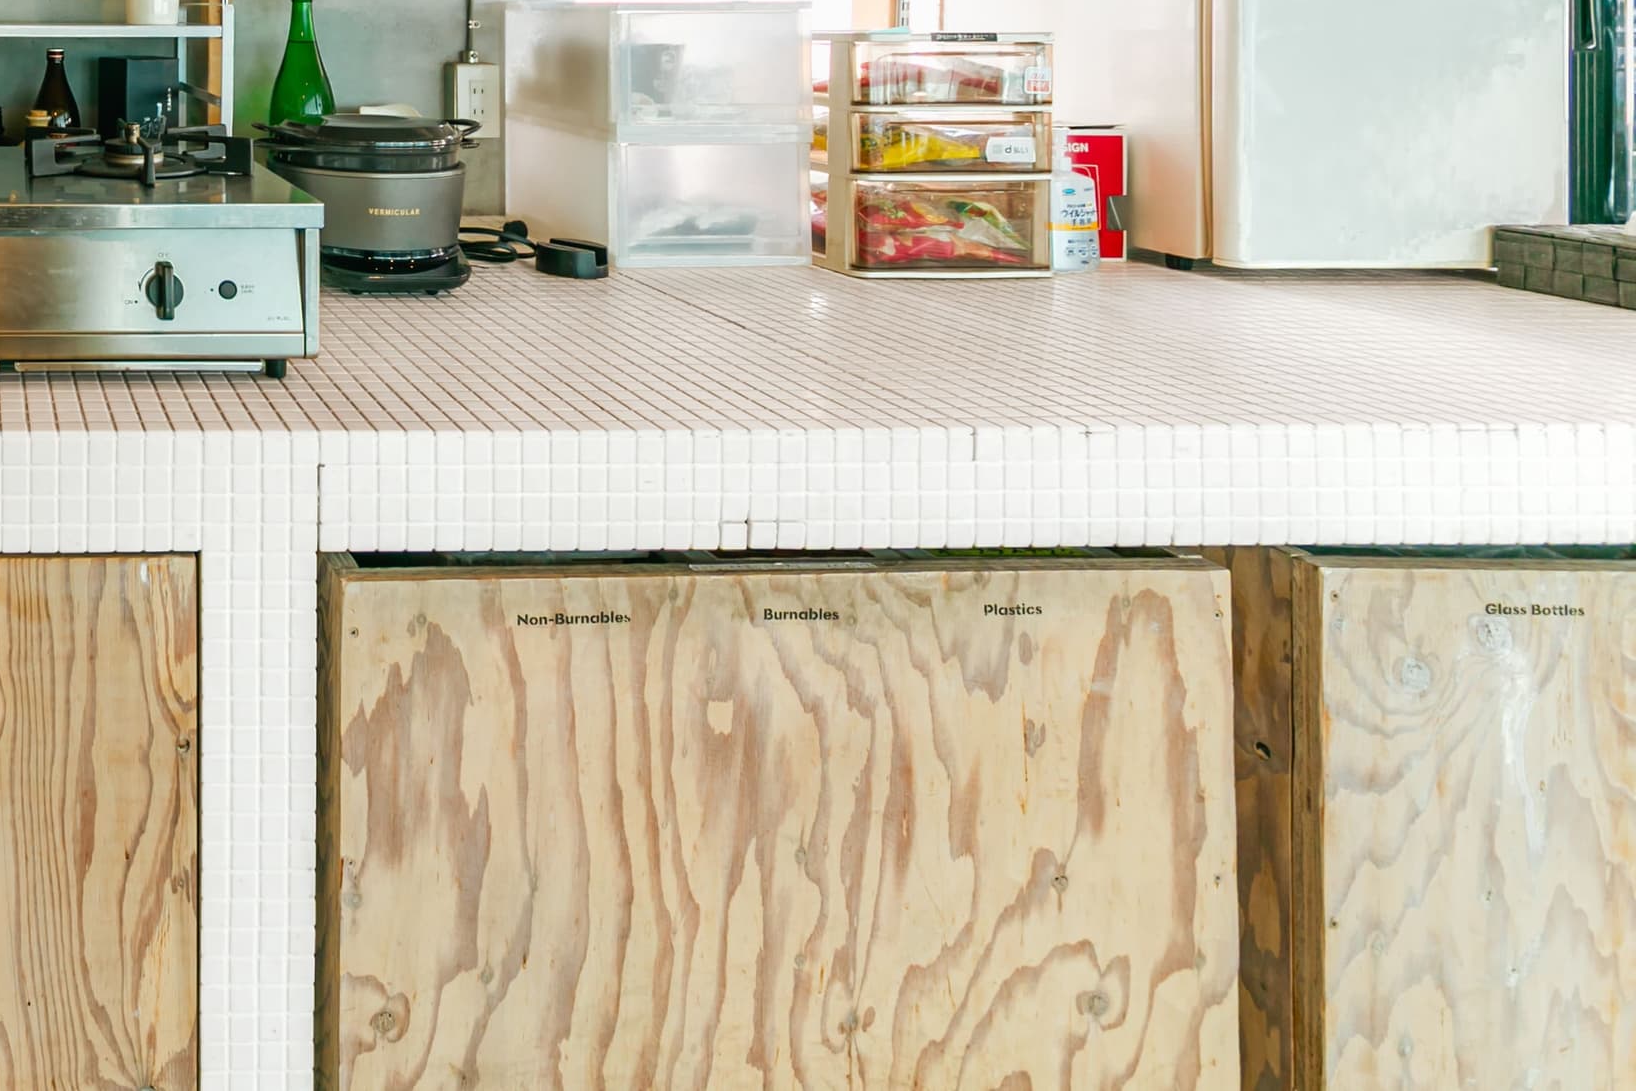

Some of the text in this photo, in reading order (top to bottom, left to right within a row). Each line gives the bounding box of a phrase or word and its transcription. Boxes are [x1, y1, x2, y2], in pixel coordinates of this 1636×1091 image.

[368, 207, 421, 216] VERMICULAR
[763, 608, 840, 621] Burnables
[983, 603, 1043, 617] Plastics
[1485, 603, 1585, 616] Glass Bottles
[516, 611, 631, 626] Non-Burnables
